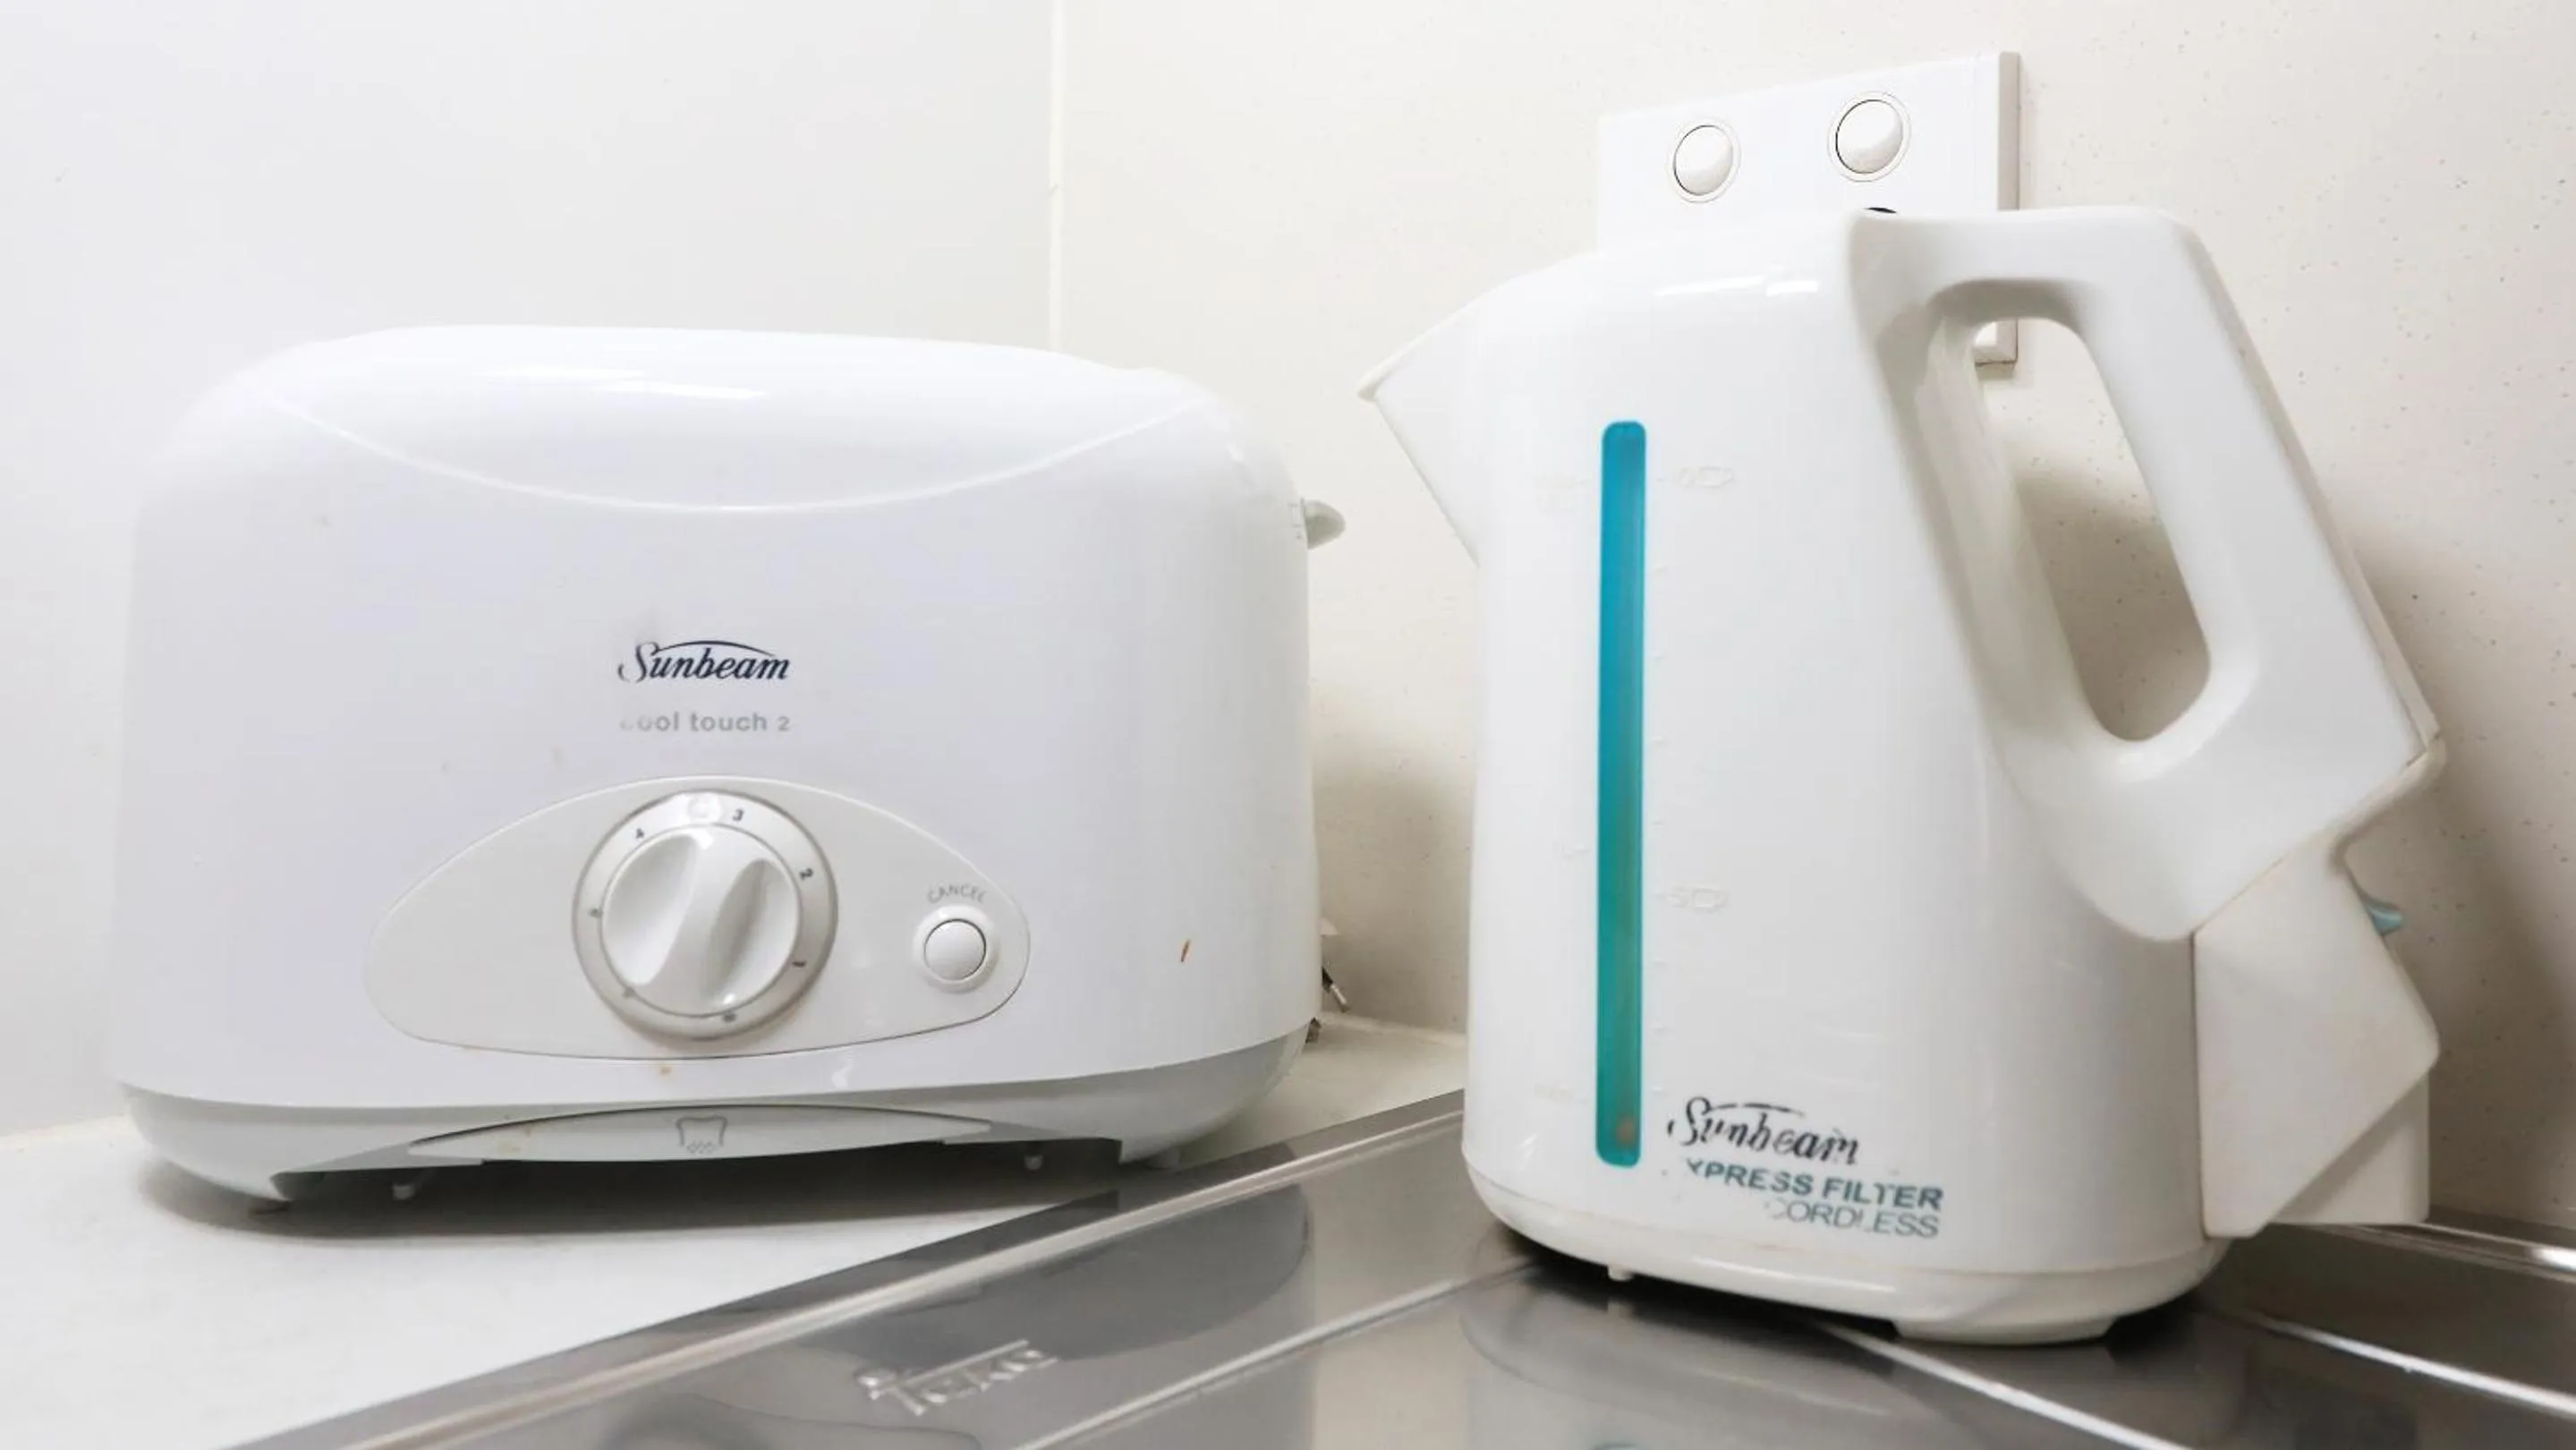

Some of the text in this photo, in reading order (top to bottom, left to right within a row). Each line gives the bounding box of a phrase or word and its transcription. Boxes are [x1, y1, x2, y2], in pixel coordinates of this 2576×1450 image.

[617, 639, 790, 683] Sunbeam
[690, 712, 768, 732] touch
[778, 716, 791, 732] 2
[1667, 1096, 1860, 1165] Sunbeam
[1822, 1176, 1945, 1212] FILTER
